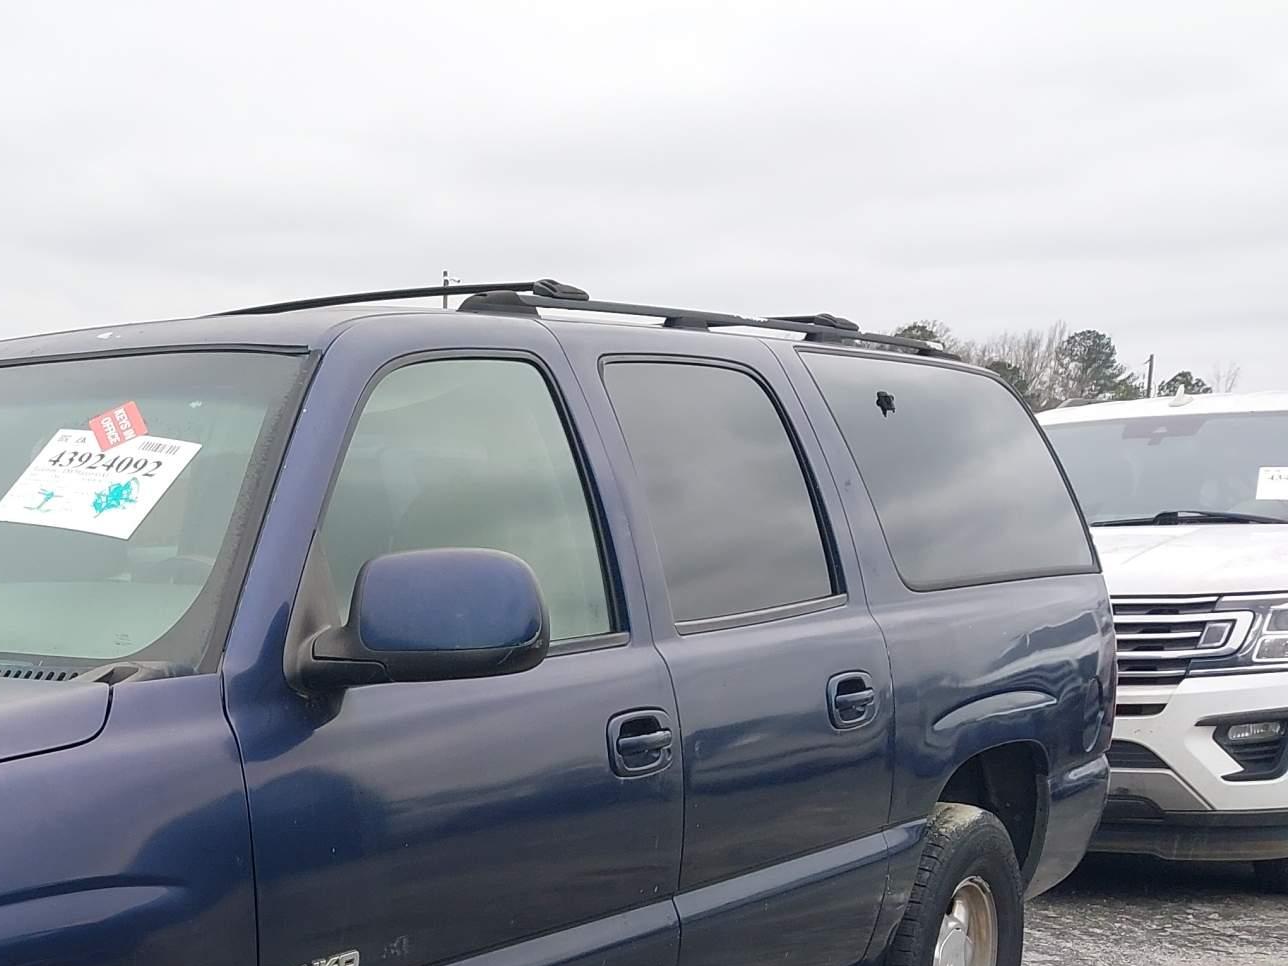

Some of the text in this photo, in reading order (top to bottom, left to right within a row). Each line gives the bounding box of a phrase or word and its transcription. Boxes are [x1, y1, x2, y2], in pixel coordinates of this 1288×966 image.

[100, 416, 122, 446] OFFICE
[114, 407, 133, 431] KEYS
[47, 449, 163, 478] 43924092
